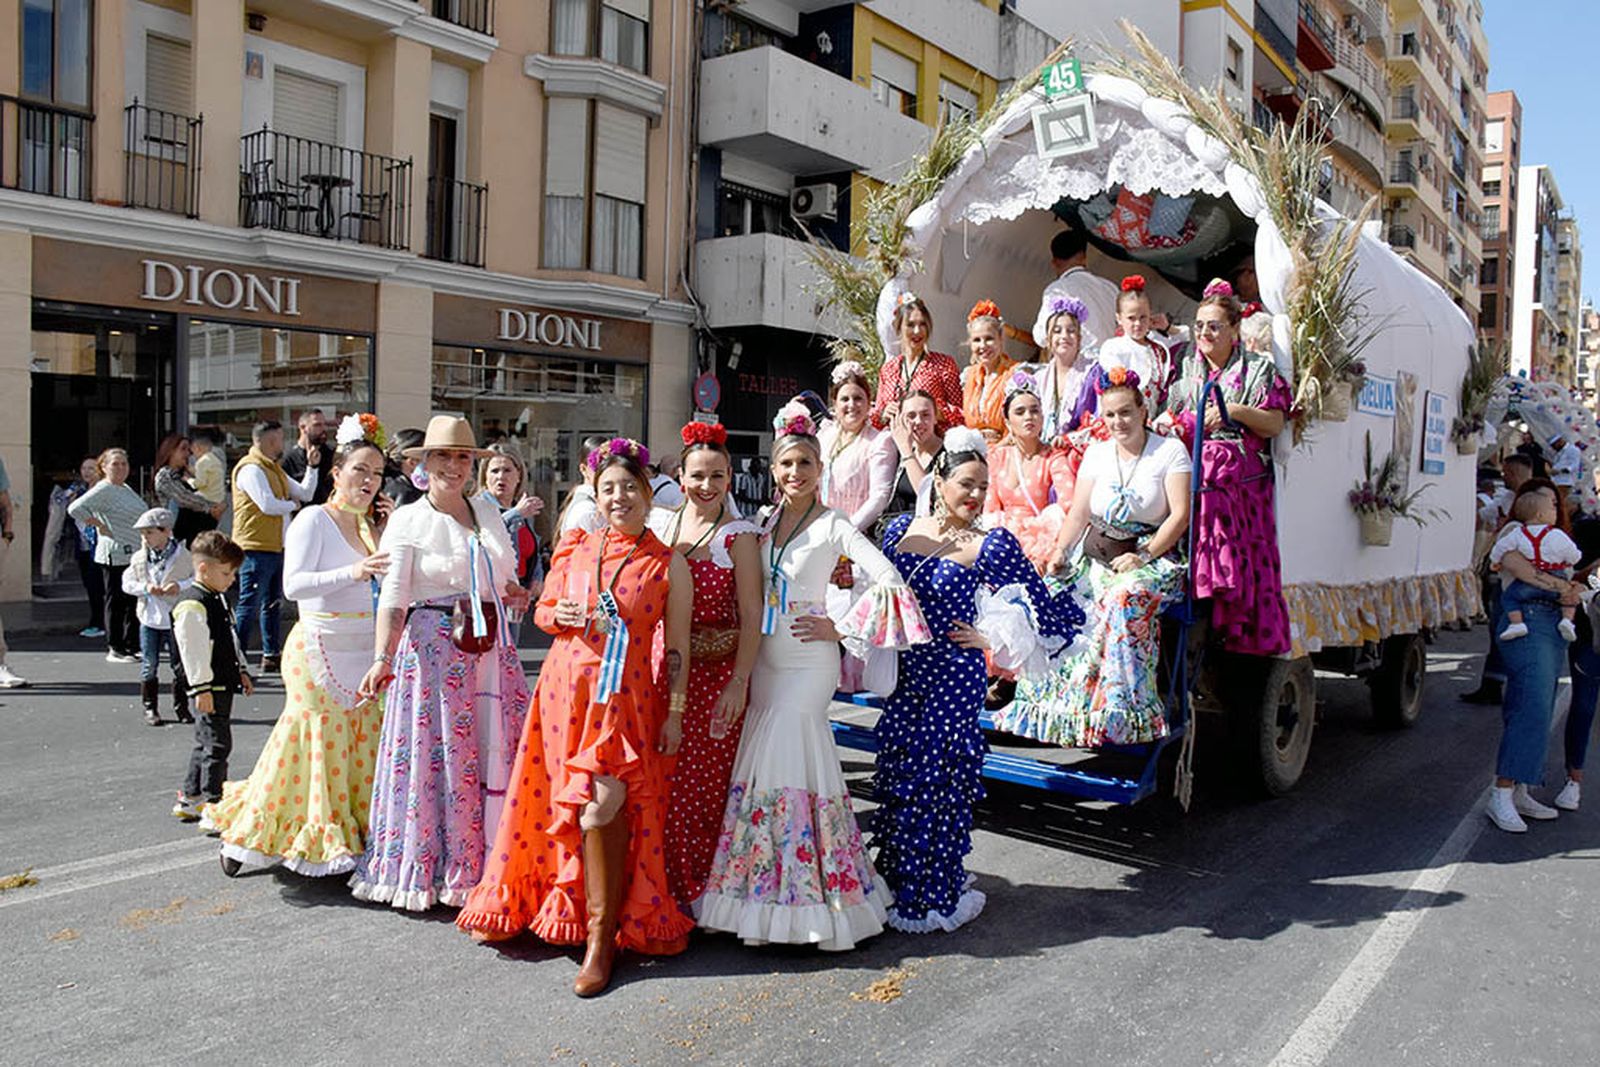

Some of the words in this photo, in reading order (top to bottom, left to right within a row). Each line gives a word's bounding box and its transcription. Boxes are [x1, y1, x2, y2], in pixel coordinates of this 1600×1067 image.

[1049, 62, 1077, 91] 45
[140, 259, 301, 316] DIONI
[497, 308, 602, 350] DIONI
[738, 372, 799, 397] TALLER
